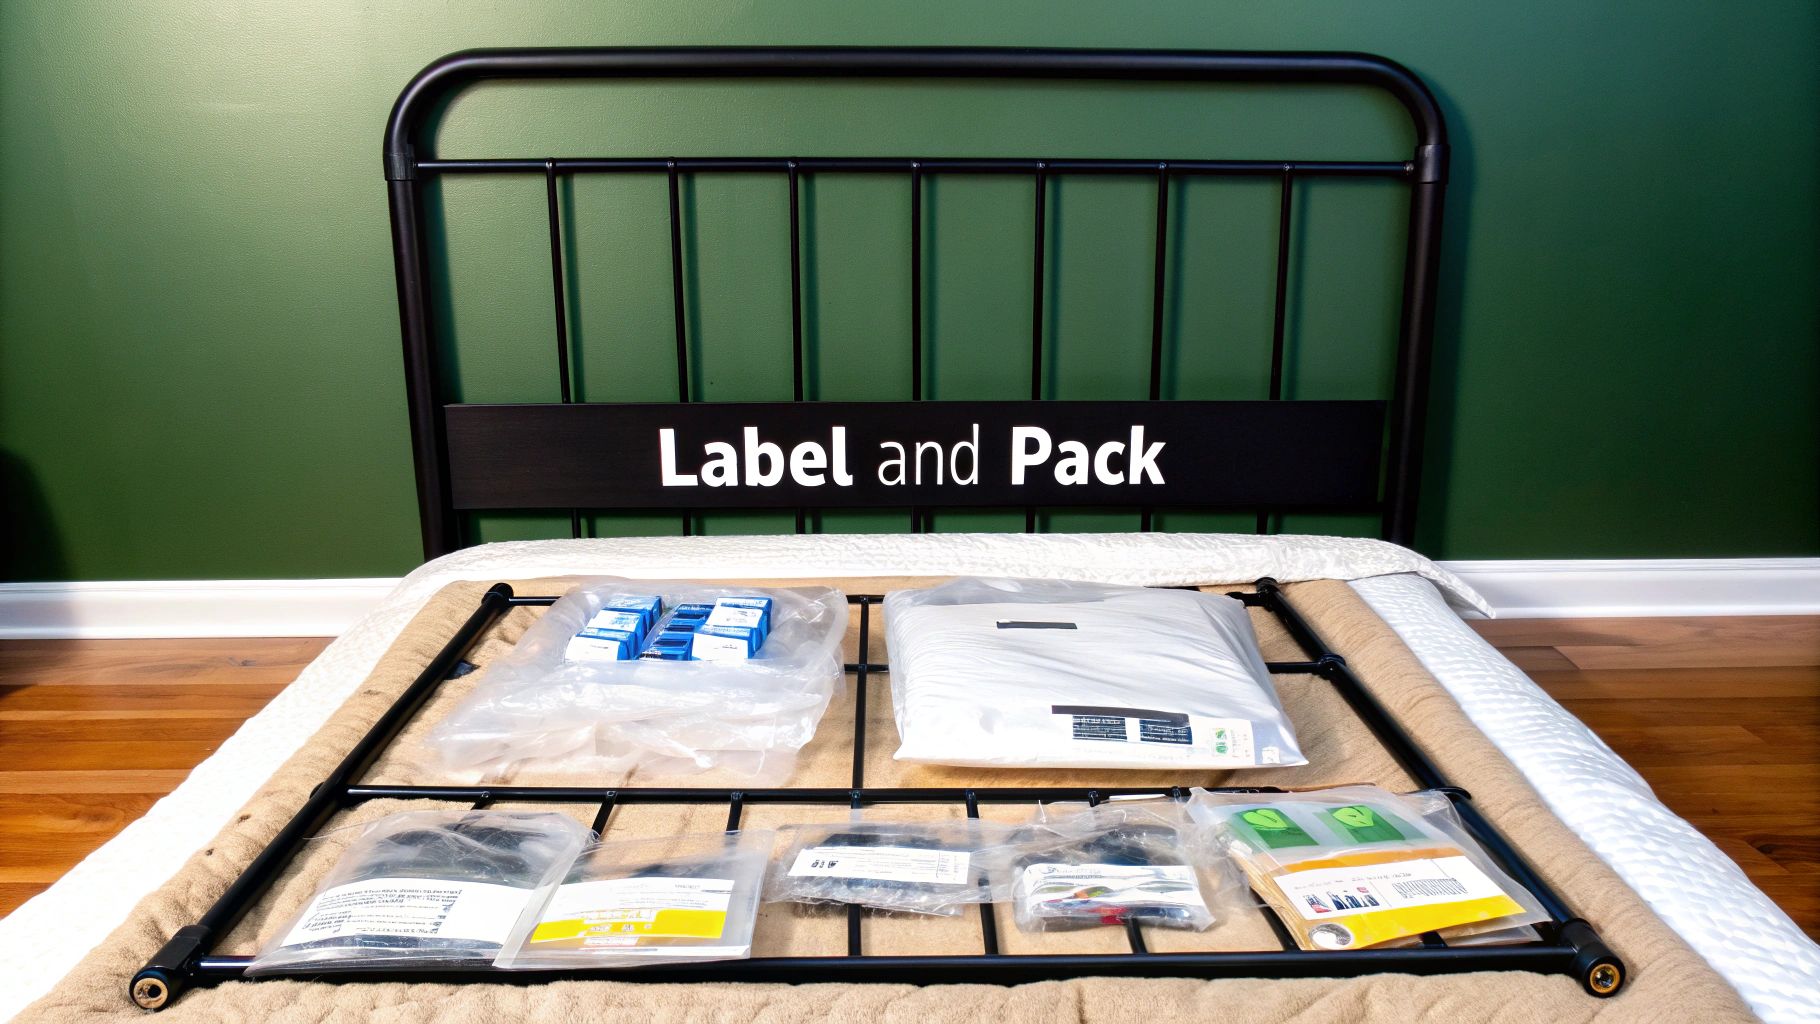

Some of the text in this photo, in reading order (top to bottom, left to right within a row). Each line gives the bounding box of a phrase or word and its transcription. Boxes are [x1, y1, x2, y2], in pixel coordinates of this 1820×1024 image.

[660, 423, 1167, 488] Label and Pack
